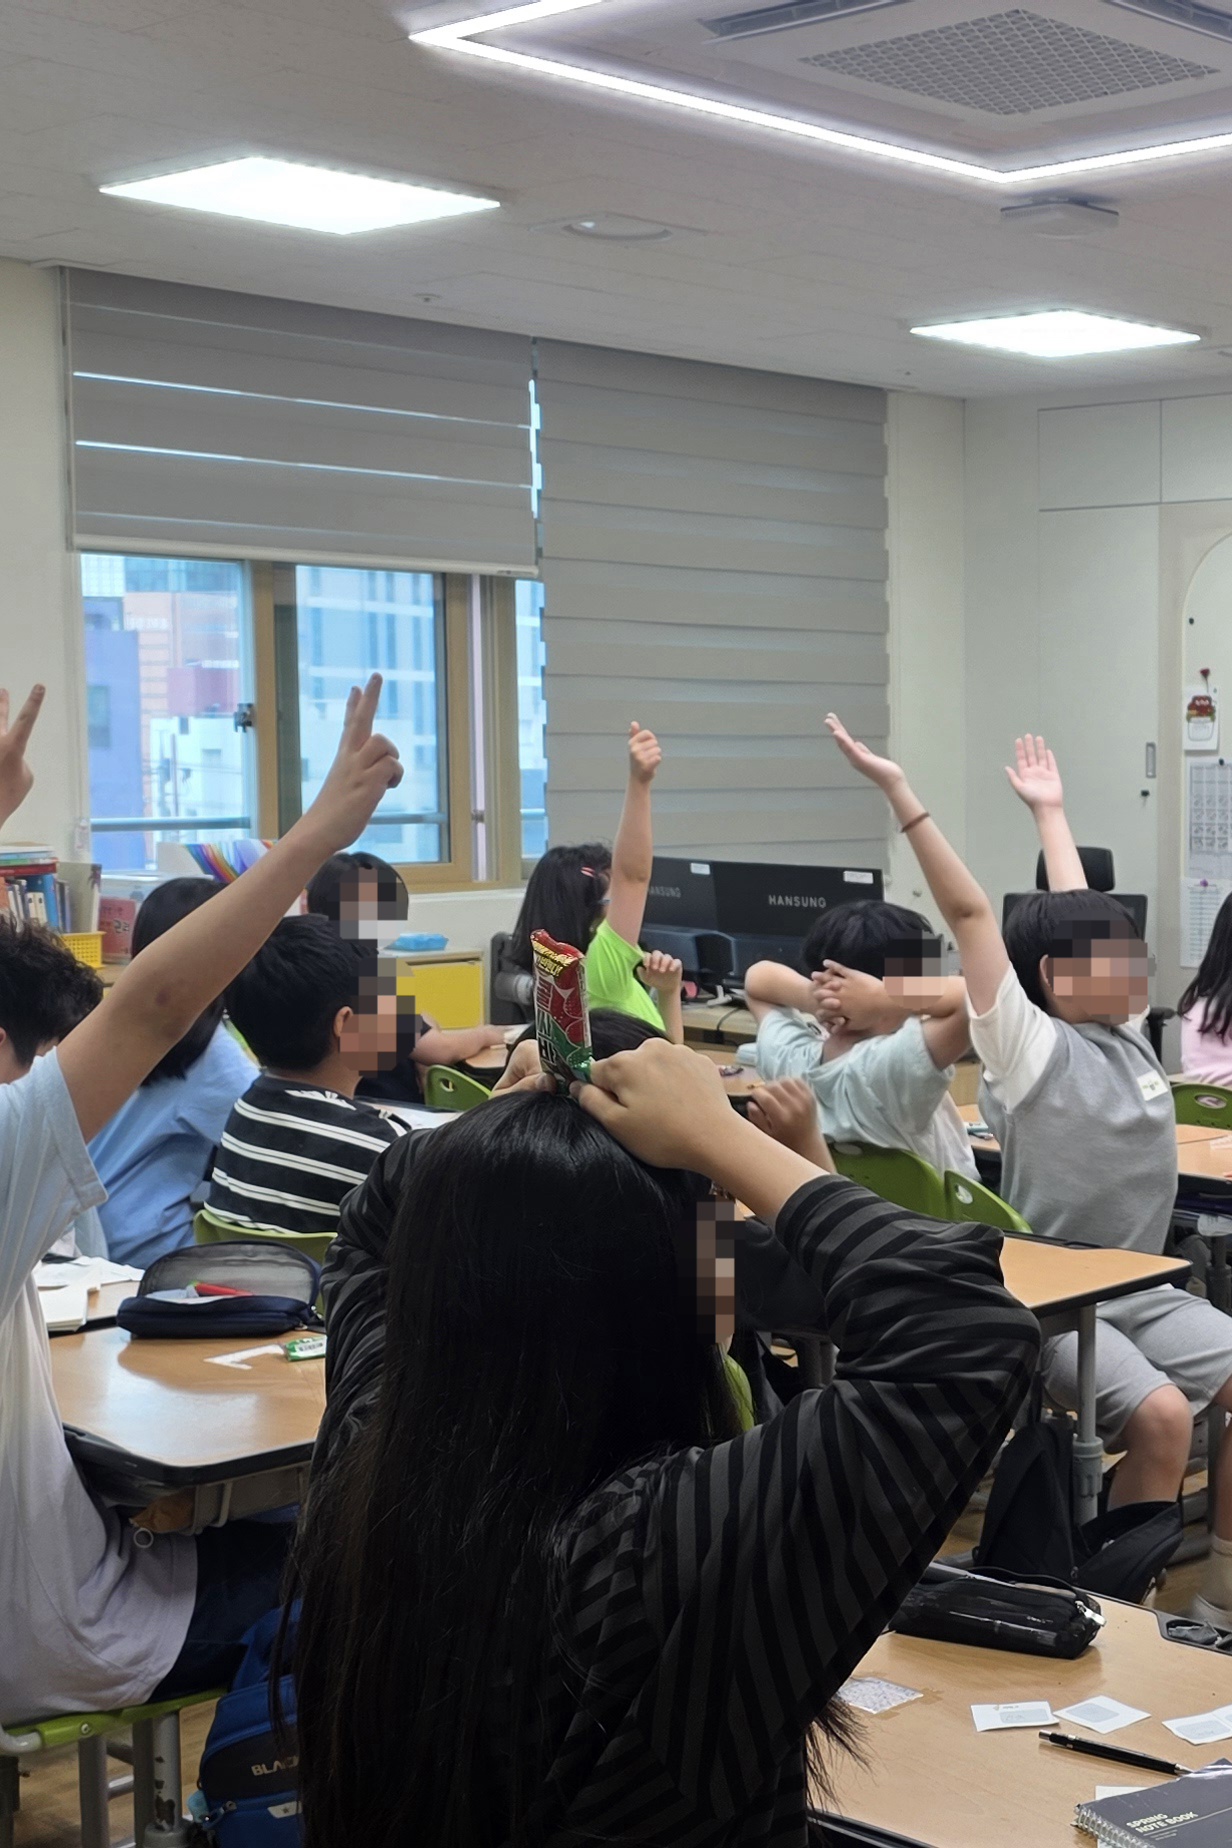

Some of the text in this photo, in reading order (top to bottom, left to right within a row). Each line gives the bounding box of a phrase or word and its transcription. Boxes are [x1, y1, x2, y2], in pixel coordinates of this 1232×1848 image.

[768, 895, 827, 908] HANSUNG
[1126, 1813, 1168, 1828] SPRING
[1135, 1811, 1199, 1833] NOTE BOOK
